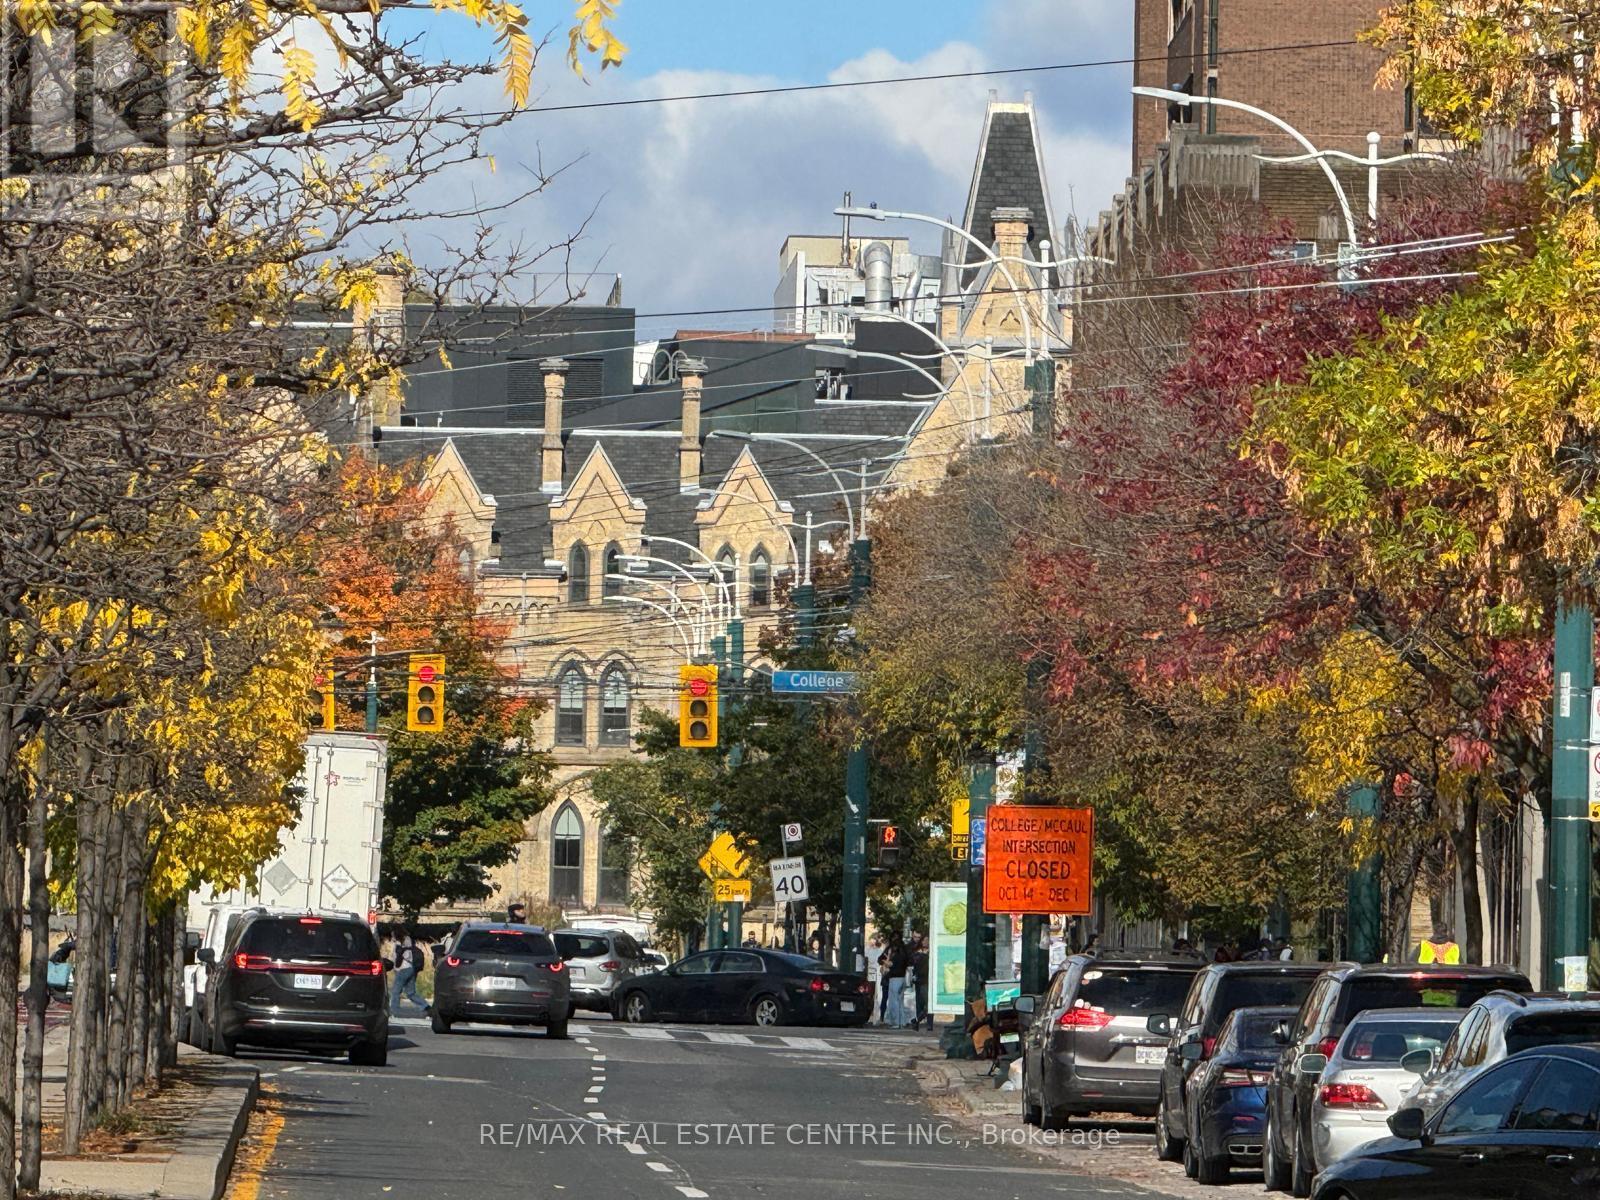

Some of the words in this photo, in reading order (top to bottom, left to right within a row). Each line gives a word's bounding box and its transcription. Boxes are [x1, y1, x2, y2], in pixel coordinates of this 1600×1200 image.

[790, 673, 844, 690] College
[1003, 839, 1076, 854] INTERSECTION
[1006, 860, 1071, 879] CLOSED
[717, 884, 731, 895] 25
[775, 875, 805, 895] 40
[998, 886, 1018, 900] OCT
[1048, 887, 1070, 901] DEC
